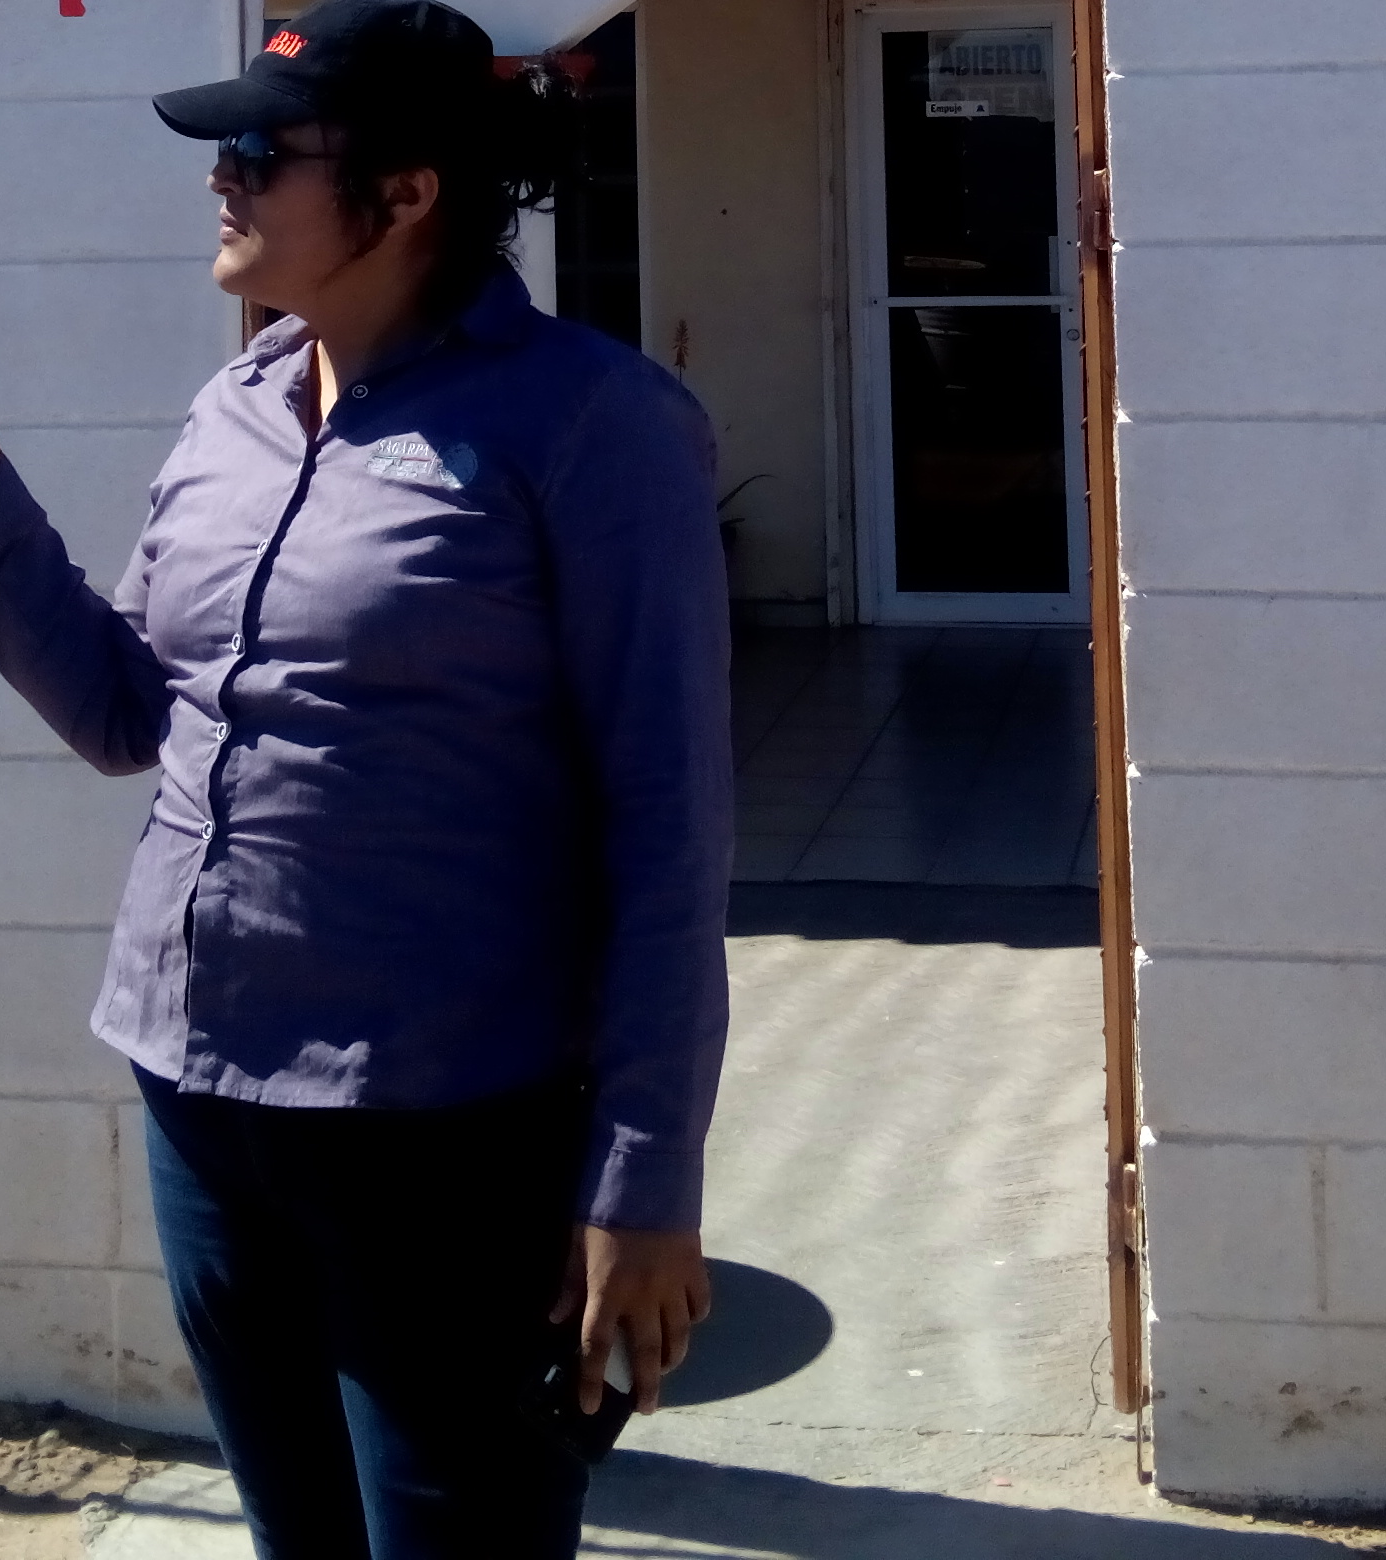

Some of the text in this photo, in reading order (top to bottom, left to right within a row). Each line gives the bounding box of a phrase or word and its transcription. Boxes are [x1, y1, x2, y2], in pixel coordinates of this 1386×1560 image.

[939, 44, 1042, 77] ABIERTO
[930, 103, 962, 115] Empuje
[377, 439, 429, 456] SAGARPA
